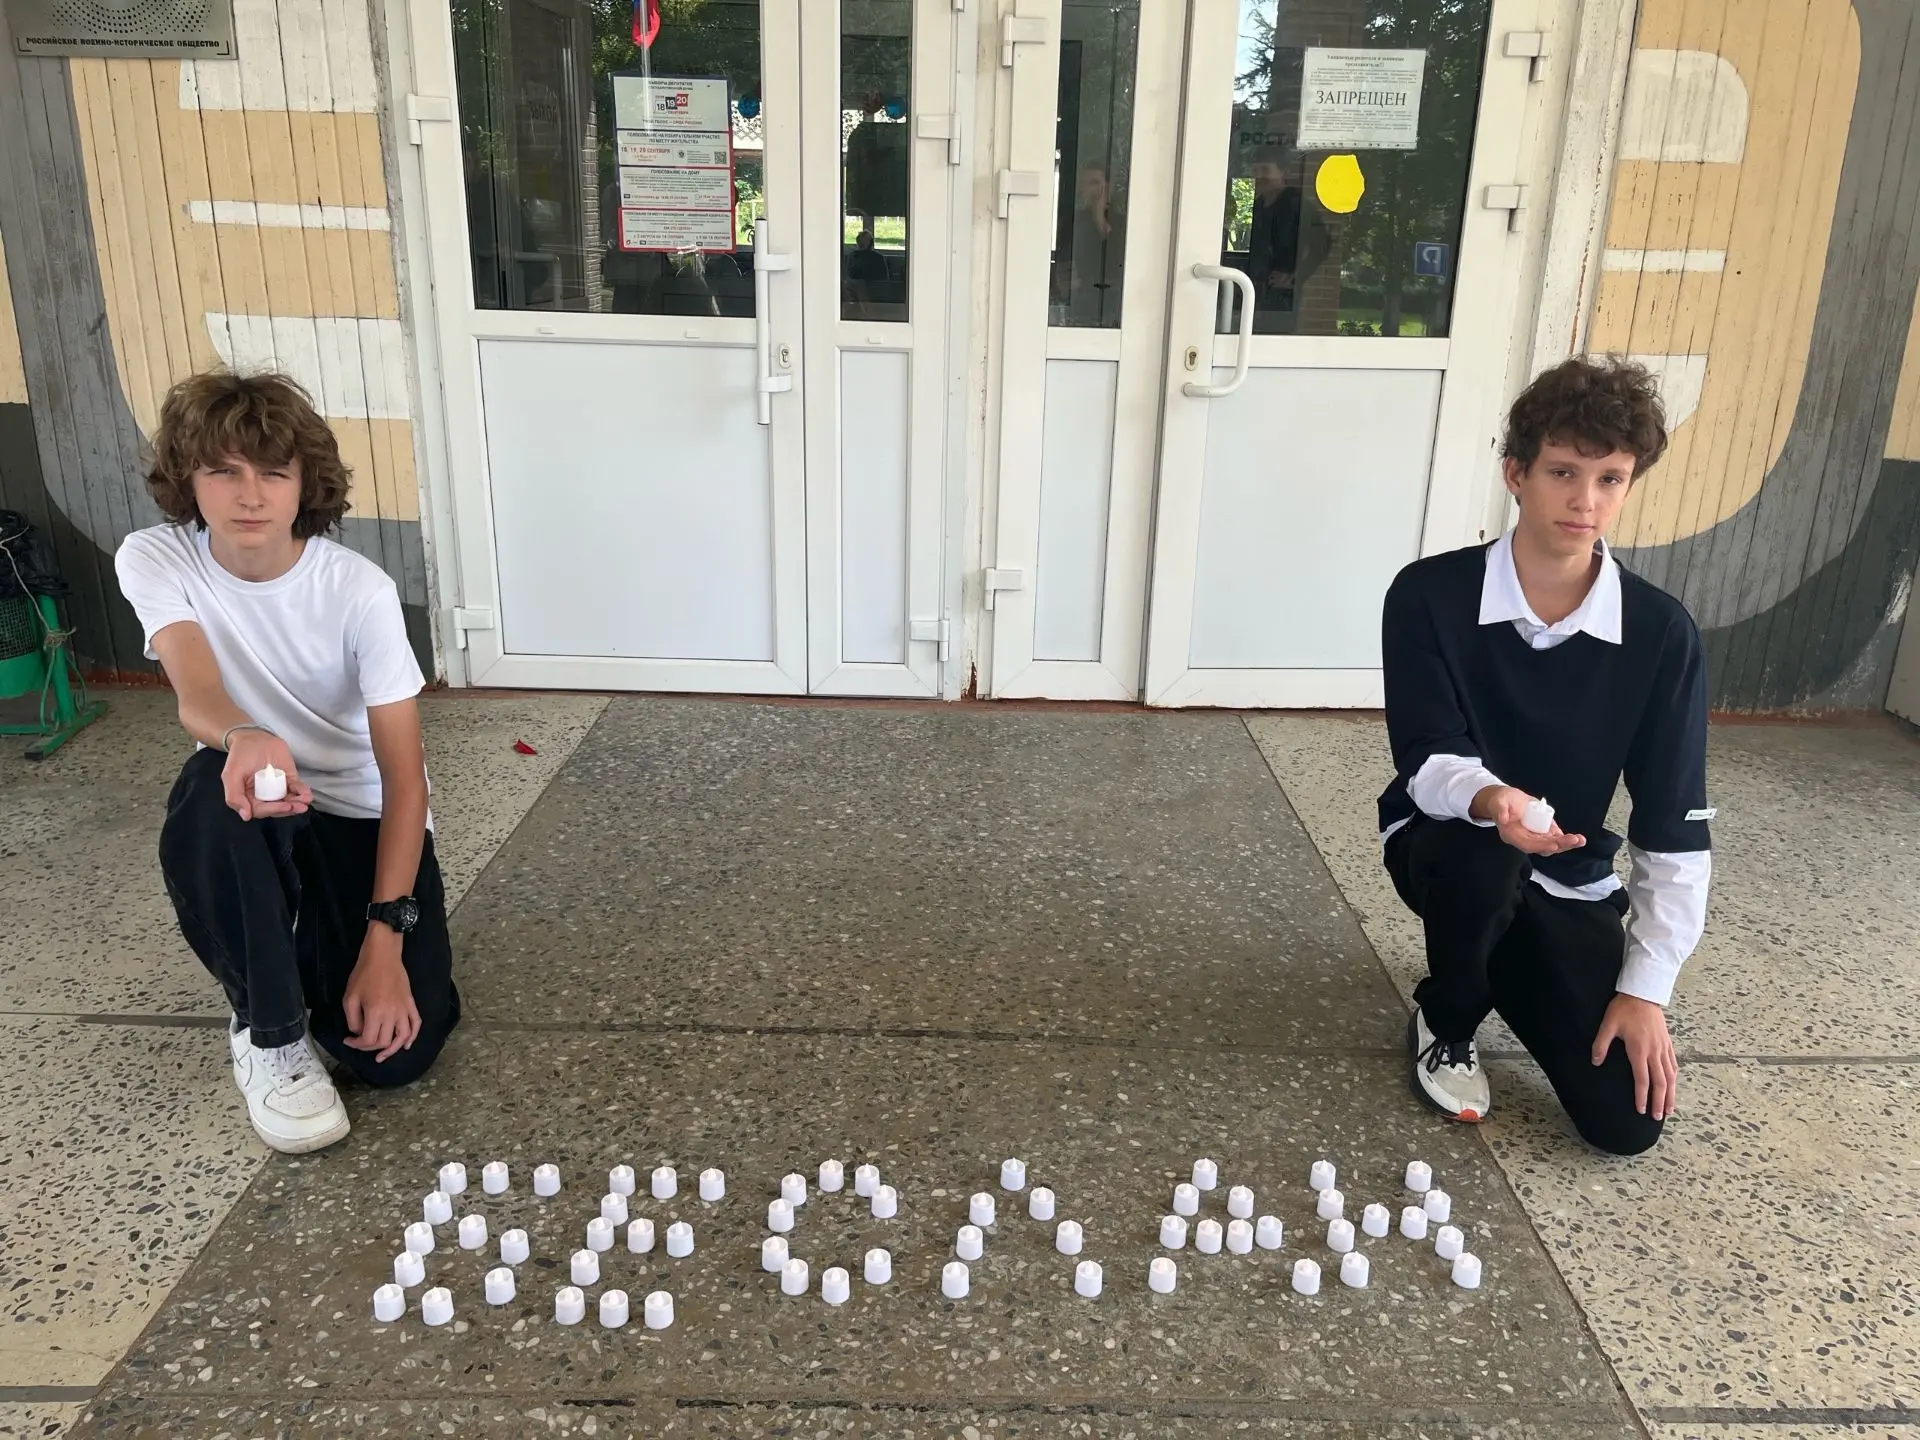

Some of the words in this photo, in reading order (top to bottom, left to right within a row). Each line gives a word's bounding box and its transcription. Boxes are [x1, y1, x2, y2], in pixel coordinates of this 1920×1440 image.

[26, 36, 77, 46] РОССИЙСКОЕ
[80, 38, 174, 48] ВОЕННО-ИСТОРИЧЕСКОЕ
[177, 40, 220, 48] ОБЩЕСТВО
[666, 99, 675, 107] 19
[676, 96, 687, 104] 20
[1315, 90, 1407, 108] ЗАПРЕЩЕН
